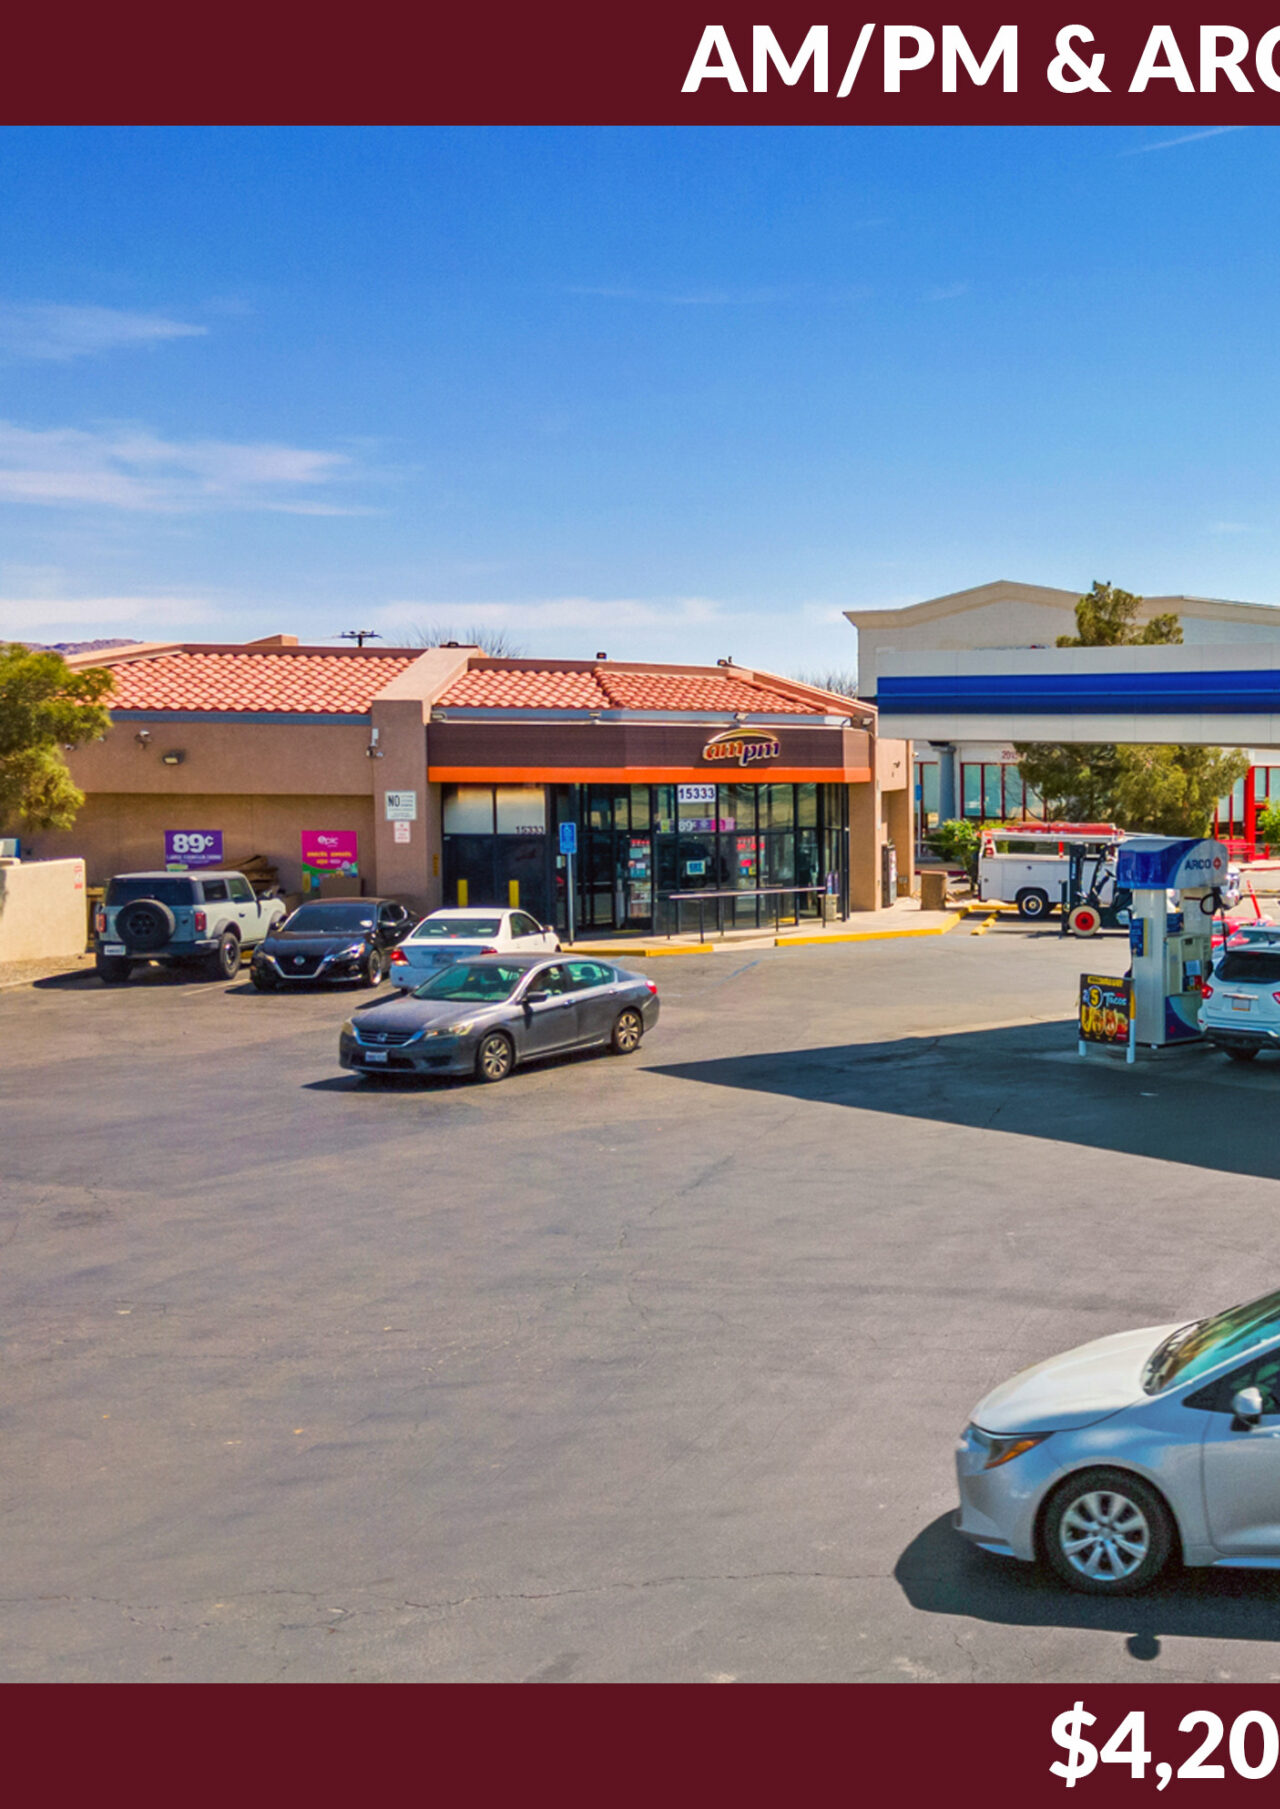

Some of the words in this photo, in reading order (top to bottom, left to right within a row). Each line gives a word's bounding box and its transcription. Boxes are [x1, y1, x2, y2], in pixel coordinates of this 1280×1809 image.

[702, 740, 780, 767] ampm
[680, 787, 715, 799] 15333
[388, 795, 400, 807] NO
[1185, 859, 1212, 870] ARCO
